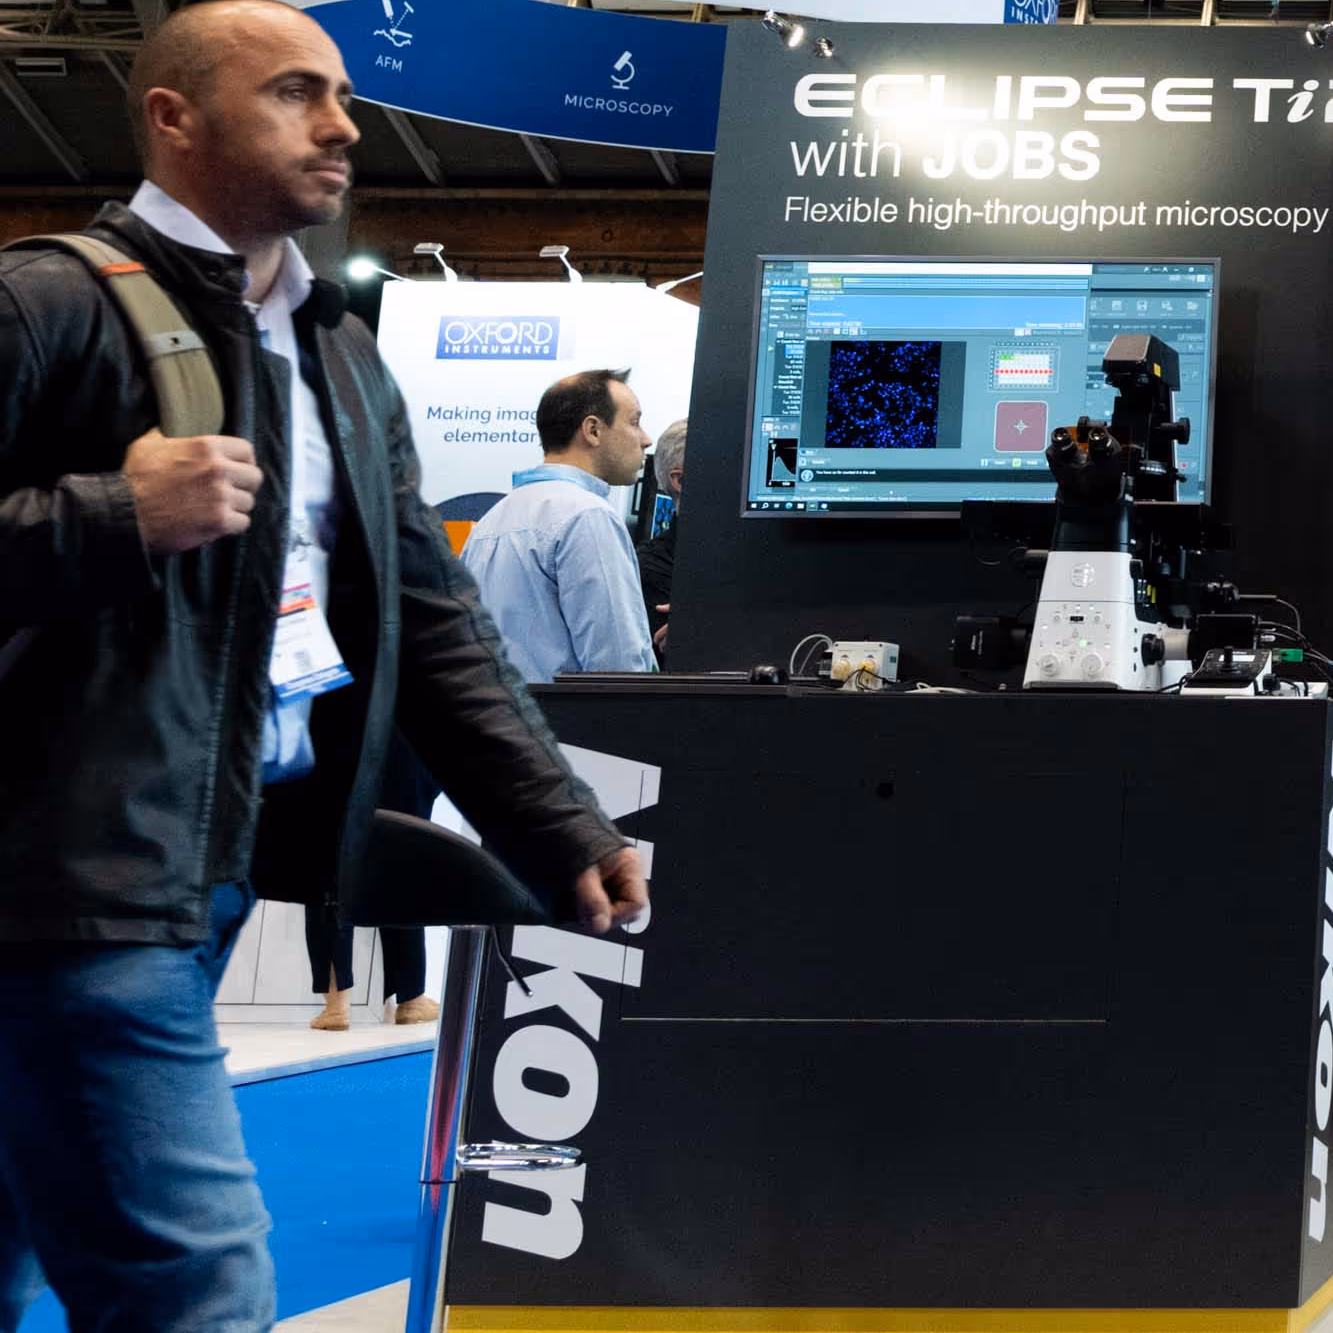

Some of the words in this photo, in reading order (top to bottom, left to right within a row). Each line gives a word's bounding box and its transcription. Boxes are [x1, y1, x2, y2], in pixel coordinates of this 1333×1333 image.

[375, 54, 403, 72] AFM
[564, 93, 674, 117] MICROSCOPY
[793, 73, 1213, 124] ECLIPSE
[790, 128, 902, 178] with
[922, 129, 1101, 181] JOBS
[784, 196, 899, 224] Flexible
[907, 197, 1147, 232] high-throughput
[1156, 200, 1329, 233] microscopy
[445, 321, 553, 345] OXFORD
[444, 345, 551, 355] INSTRUMENTS
[426, 406, 492, 424] Making
[443, 429, 543, 446] elementar
